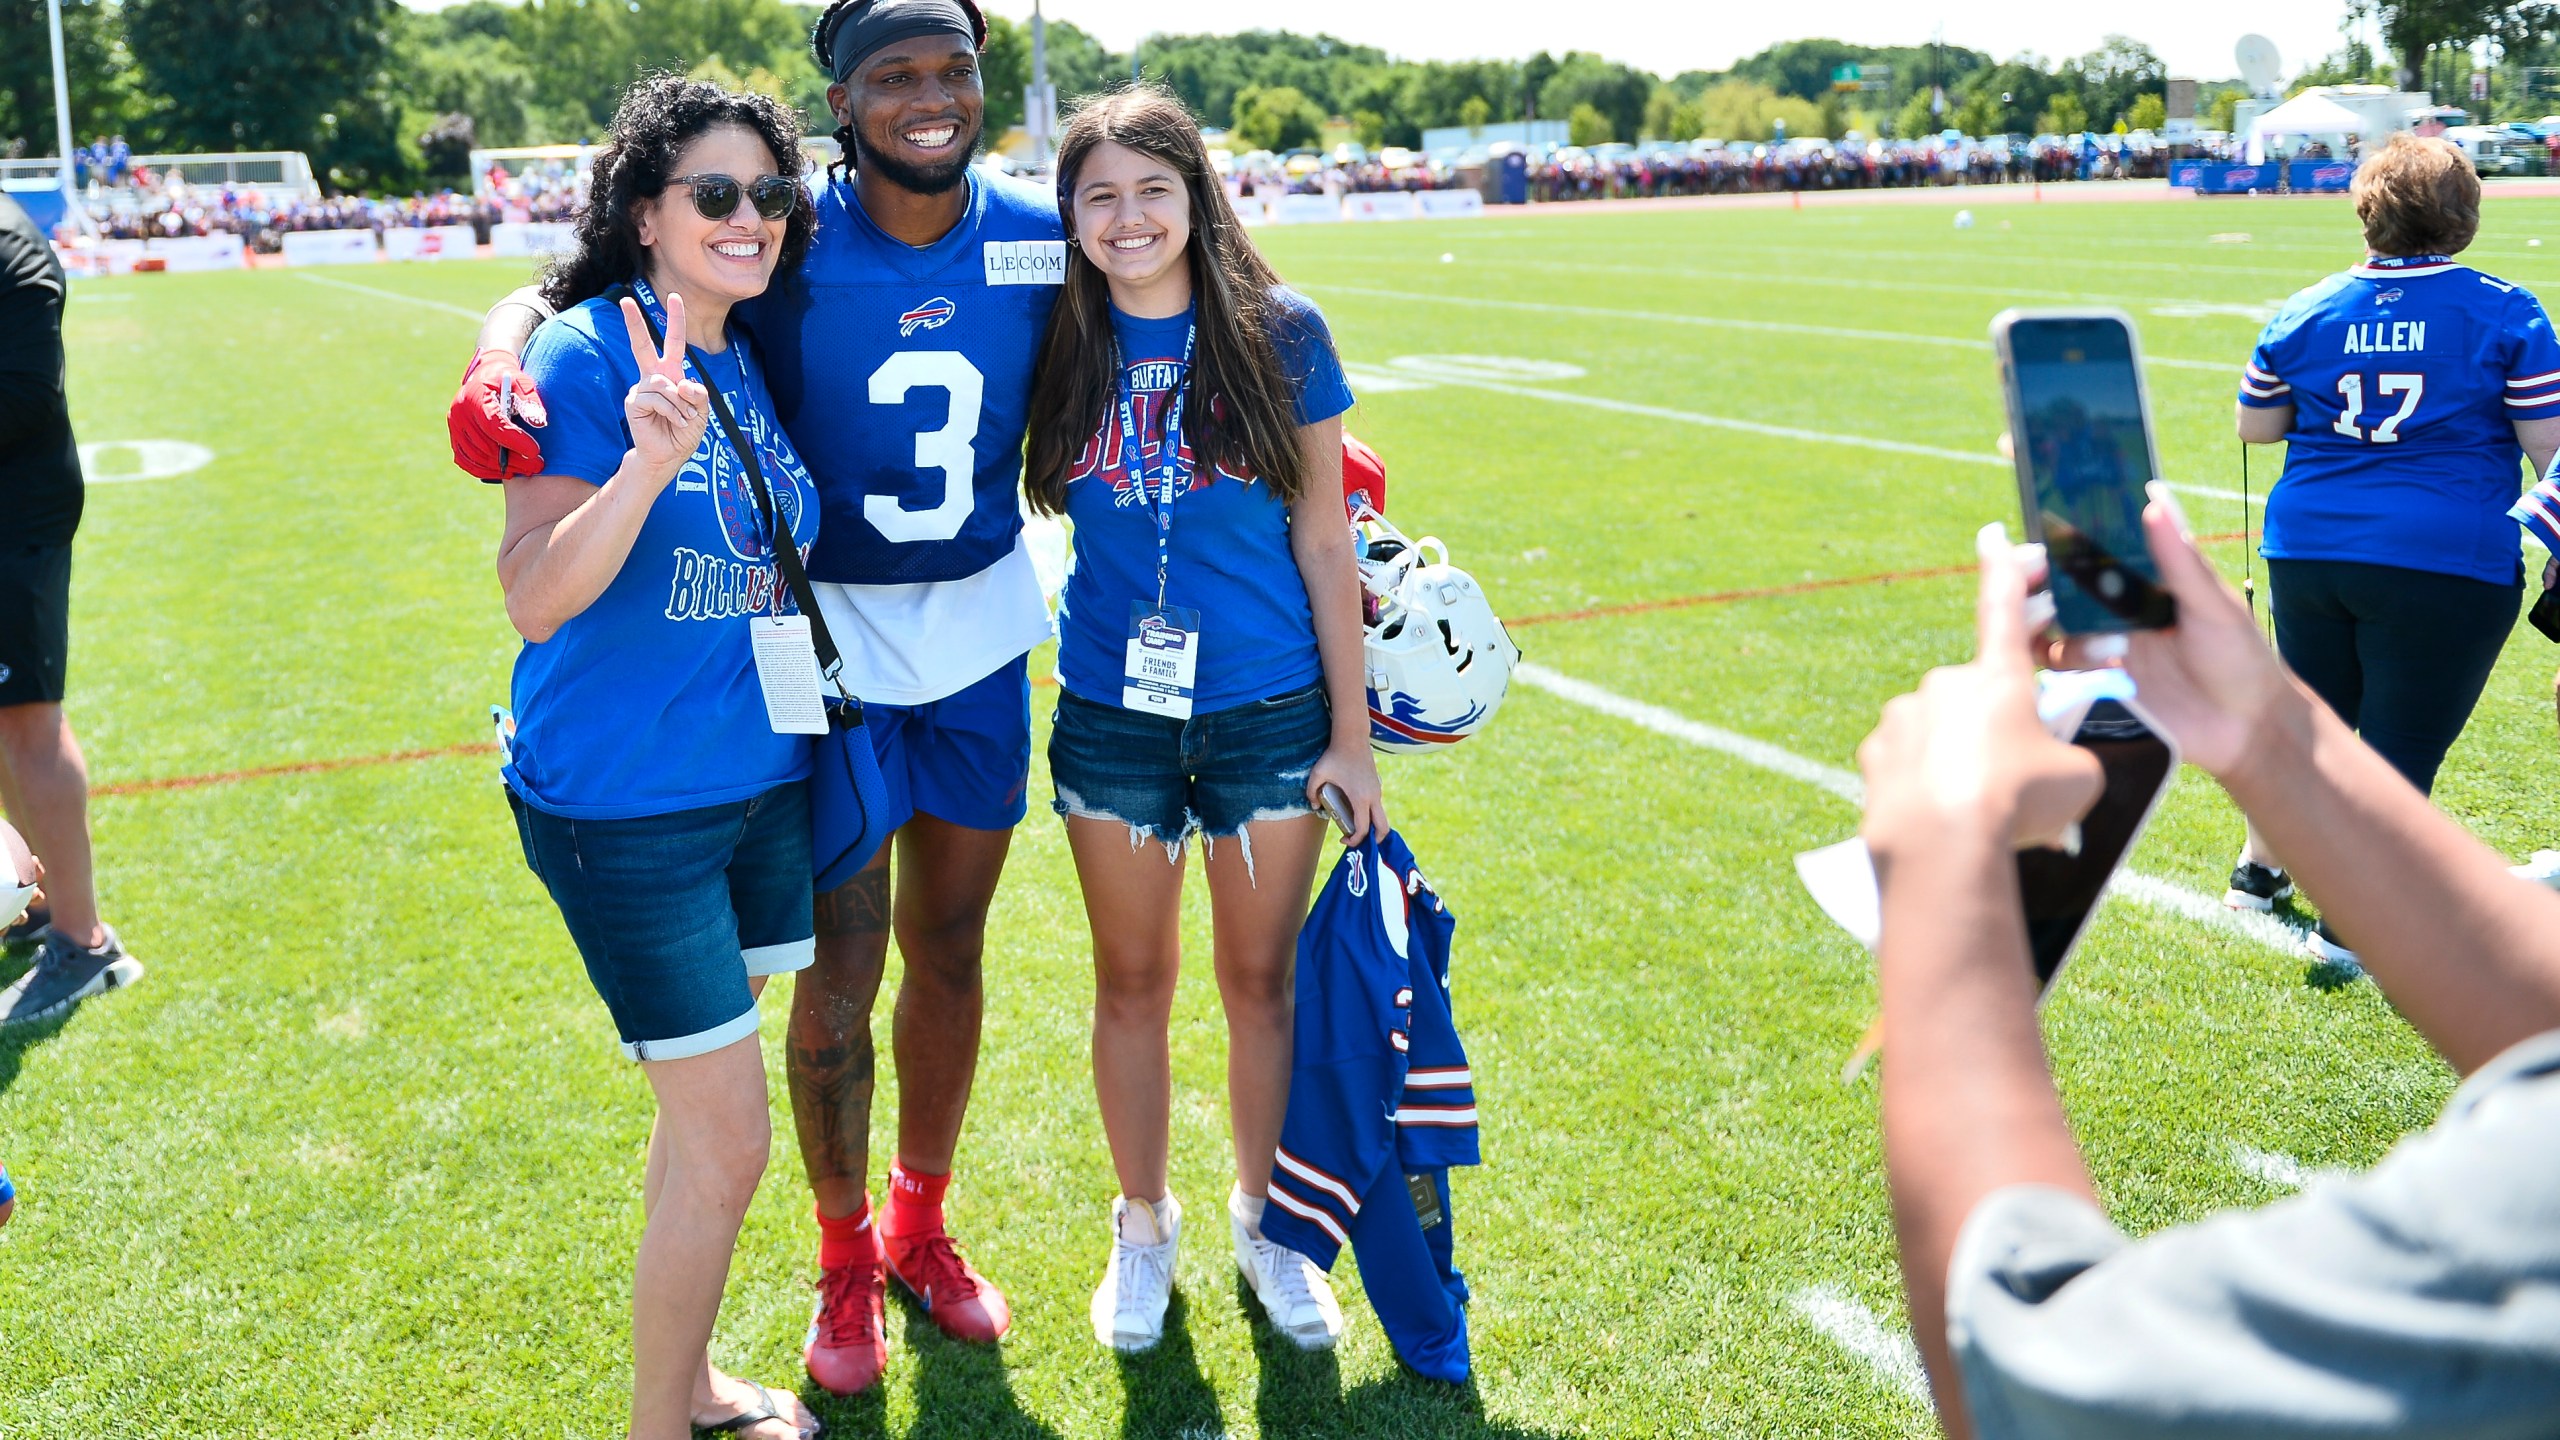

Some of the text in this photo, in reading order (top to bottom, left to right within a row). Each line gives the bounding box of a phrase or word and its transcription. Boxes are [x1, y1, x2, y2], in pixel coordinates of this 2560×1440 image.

[988, 255, 1063, 272] LECOM
[2344, 321, 2426, 354] ALLEN
[1132, 364, 1190, 389] BUFFAL
[1120, 401, 1134, 437] BILLS
[1170, 395, 1181, 431] BILLS
[2332, 373, 2424, 443] 17
[863, 350, 985, 543] 3
[1131, 469, 1148, 505] BILLS
[1160, 466, 1173, 504] BILLS
[1144, 657, 1177, 669] FRIENDS
[1149, 666, 1178, 679] FAMILY
